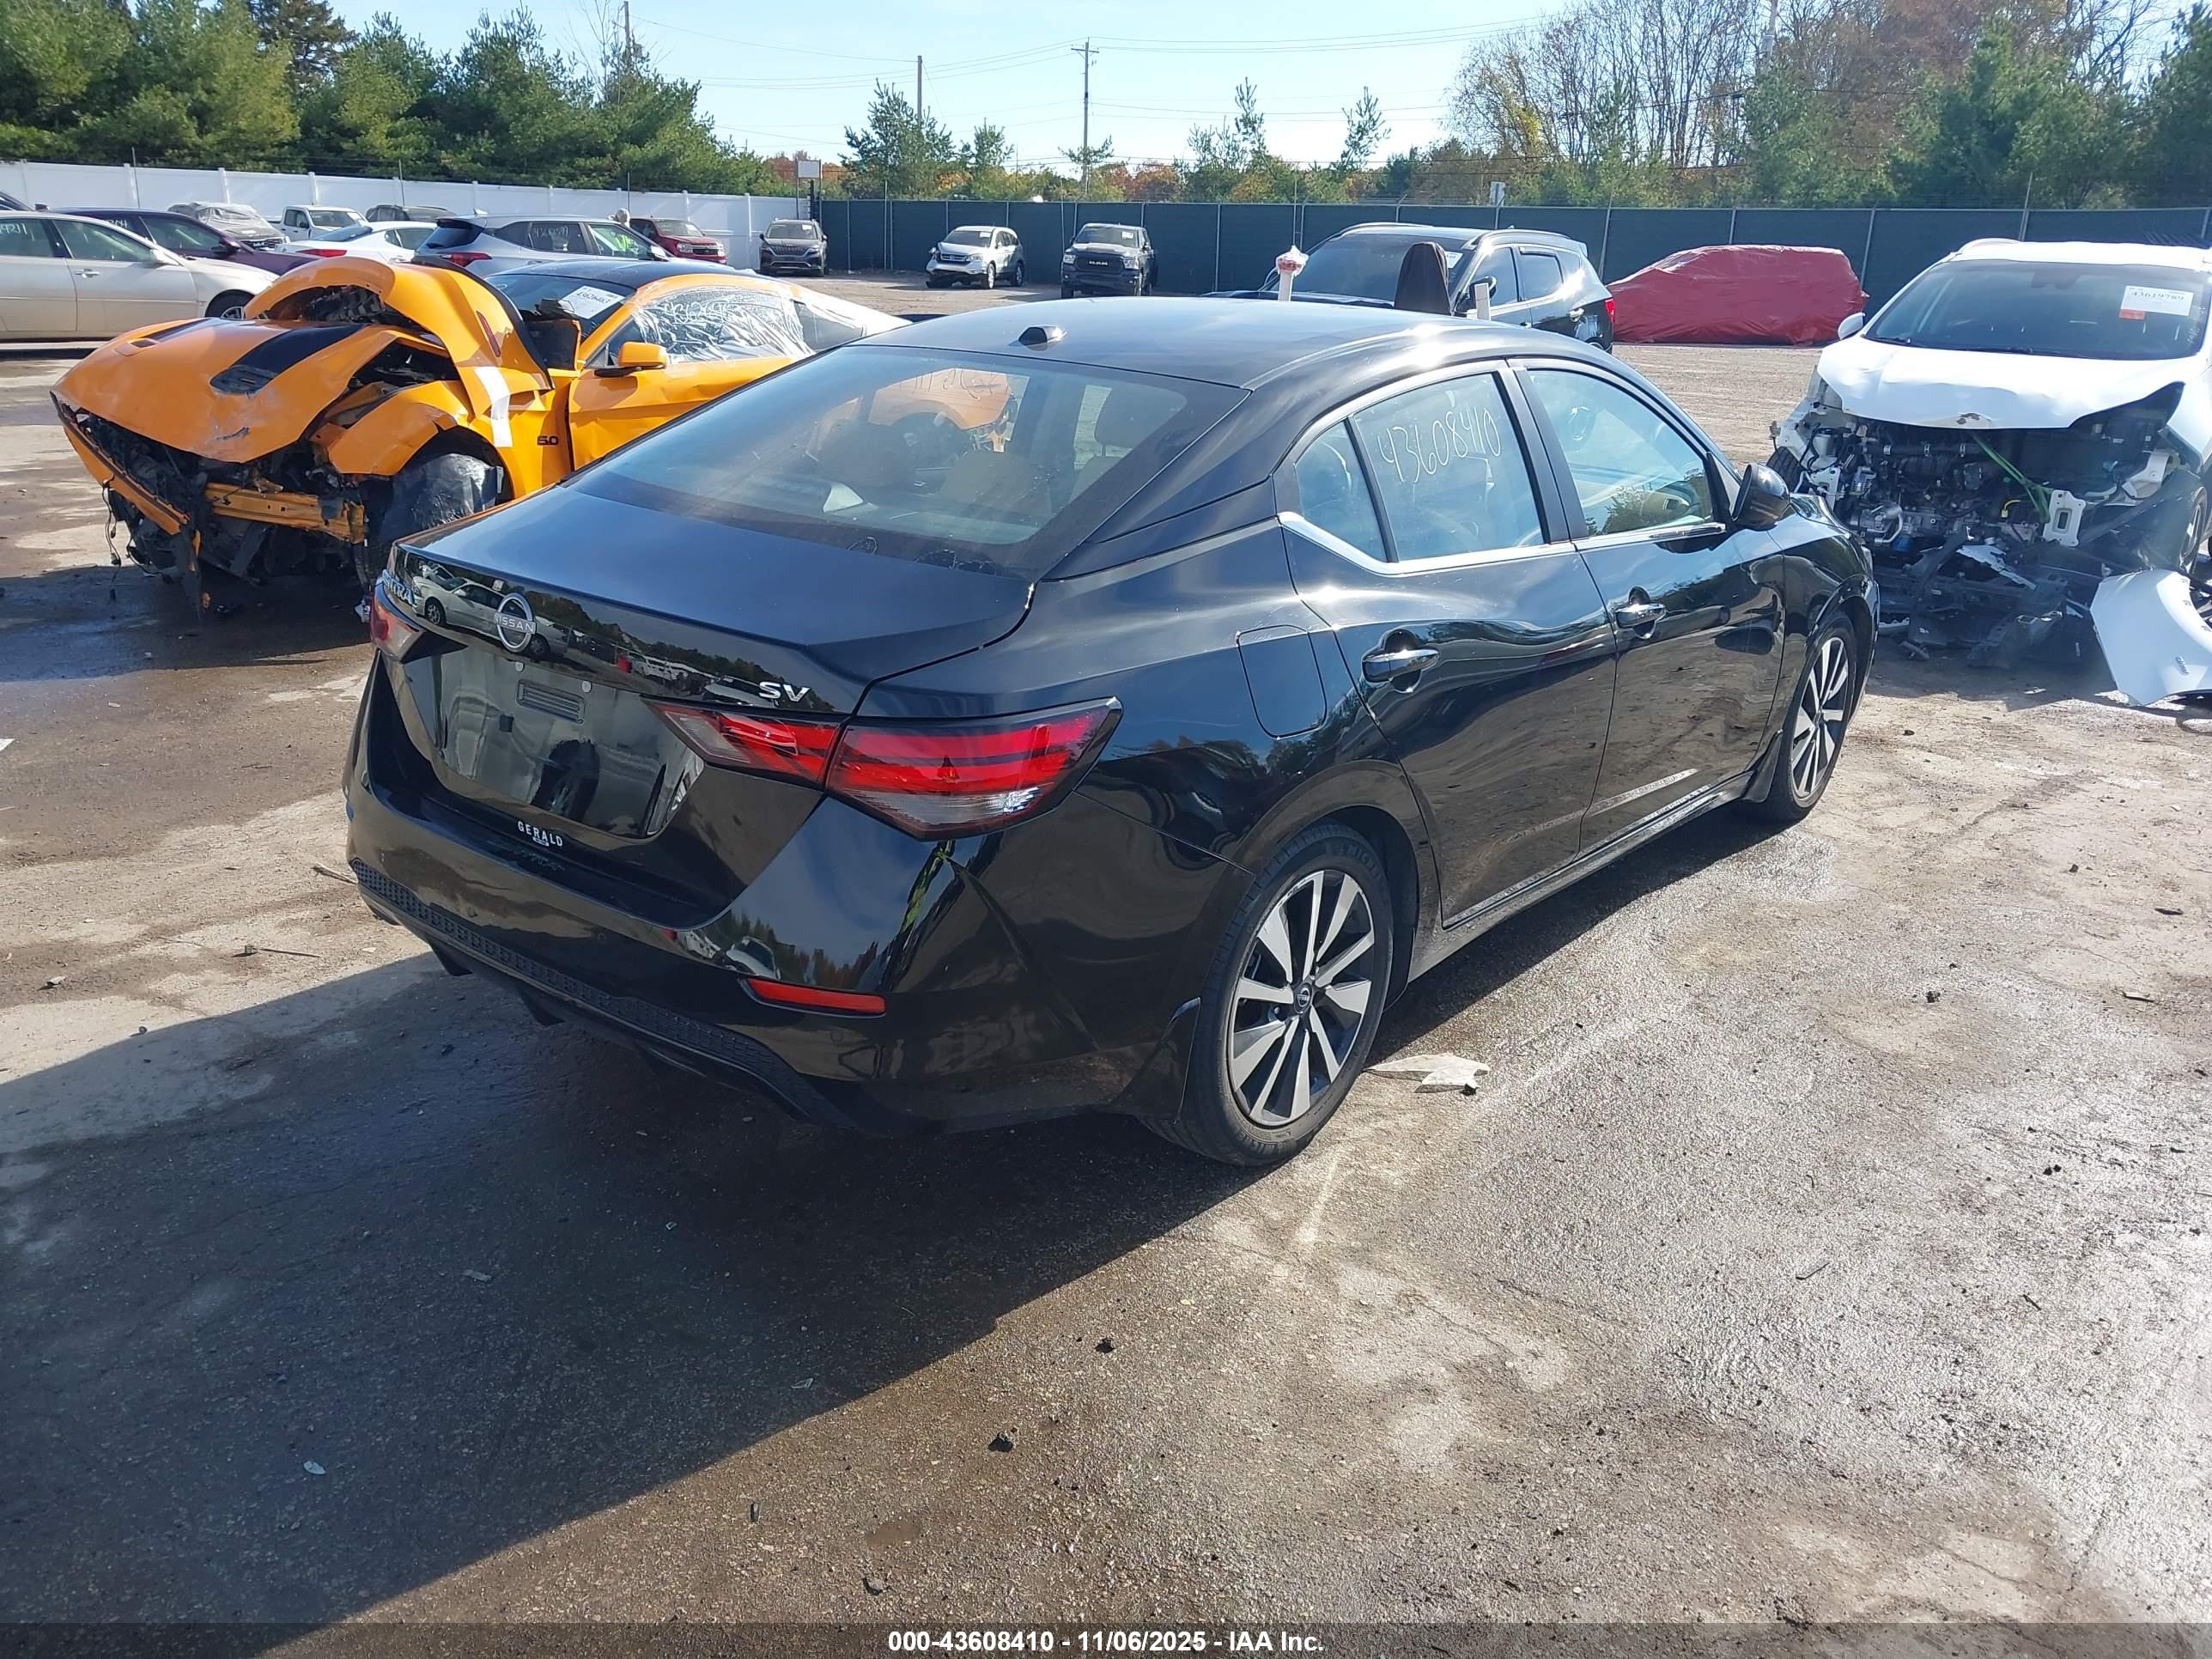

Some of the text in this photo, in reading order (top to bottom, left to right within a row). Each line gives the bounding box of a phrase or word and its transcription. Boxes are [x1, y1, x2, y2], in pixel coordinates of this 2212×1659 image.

[1377, 404, 1502, 483] 43608410
[495, 612, 534, 632] NISSAN
[758, 681, 811, 702] SV
[517, 820, 563, 847] GERALD
